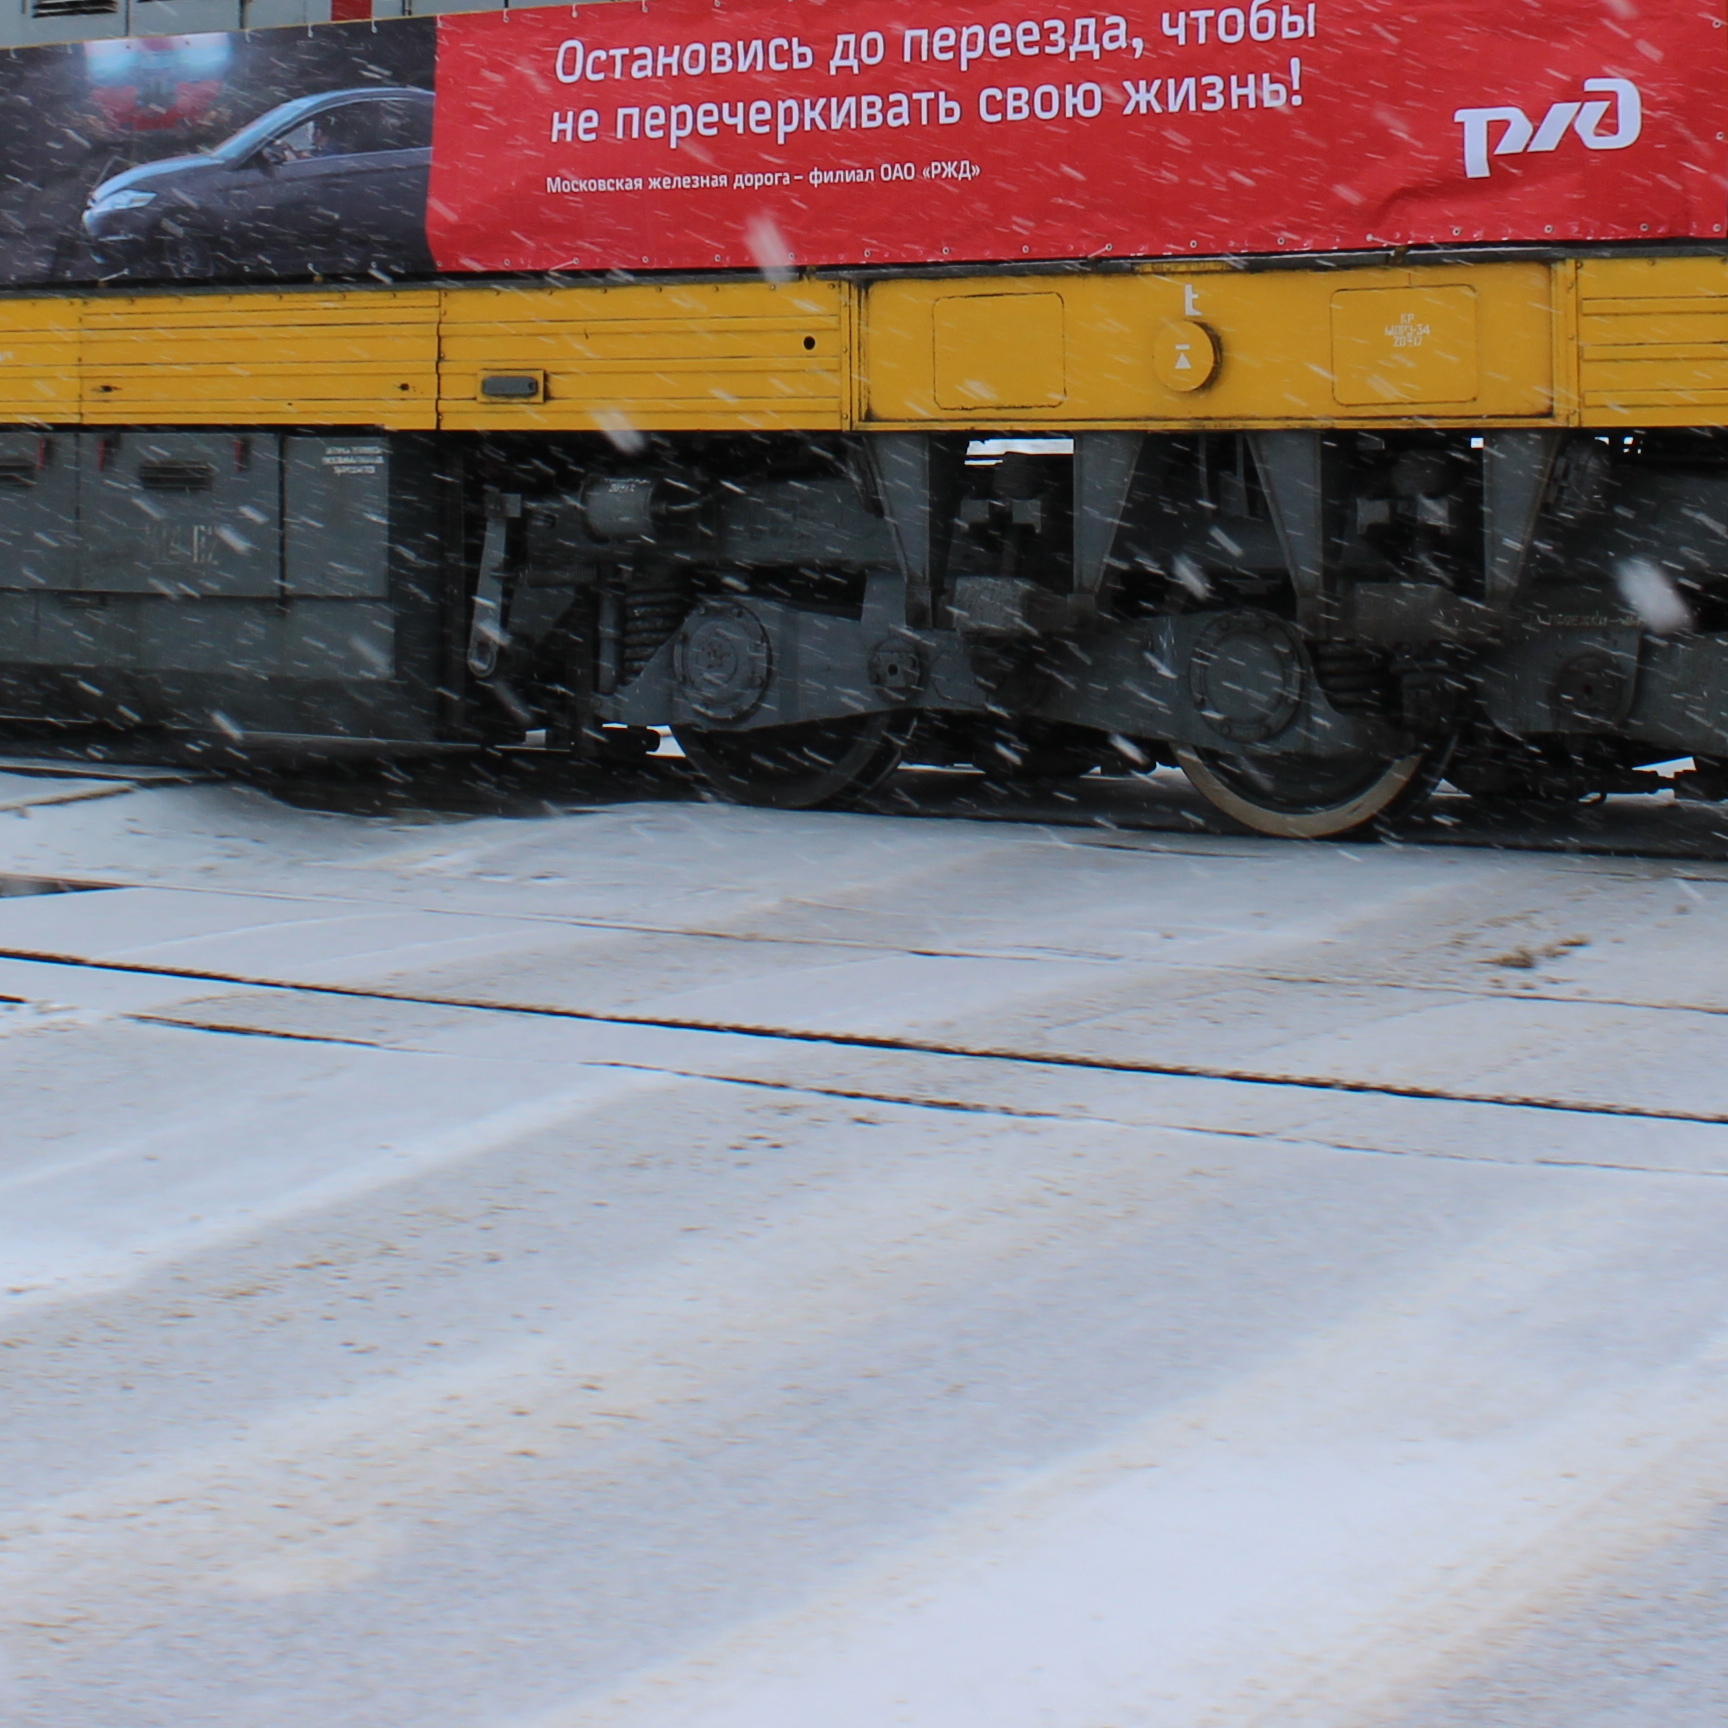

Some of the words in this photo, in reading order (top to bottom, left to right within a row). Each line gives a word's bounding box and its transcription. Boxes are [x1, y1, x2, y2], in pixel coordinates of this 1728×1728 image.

[554, 36, 815, 85] Остановись
[827, 29, 886, 76] до
[901, 14, 1145, 72] переезда,
[550, 107, 600, 144] не
[615, 90, 963, 150] перечеркивать
[978, 81, 1104, 123] свою
[1121, 56, 1304, 116] жизнь!
[545, 175, 644, 194] Московская
[647, 173, 729, 191] железная
[732, 170, 791, 191] дорога
[808, 166, 876, 189] филиал
[880, 162, 916, 183] ОАО
[921, 158, 982, 181] «РЖД»
